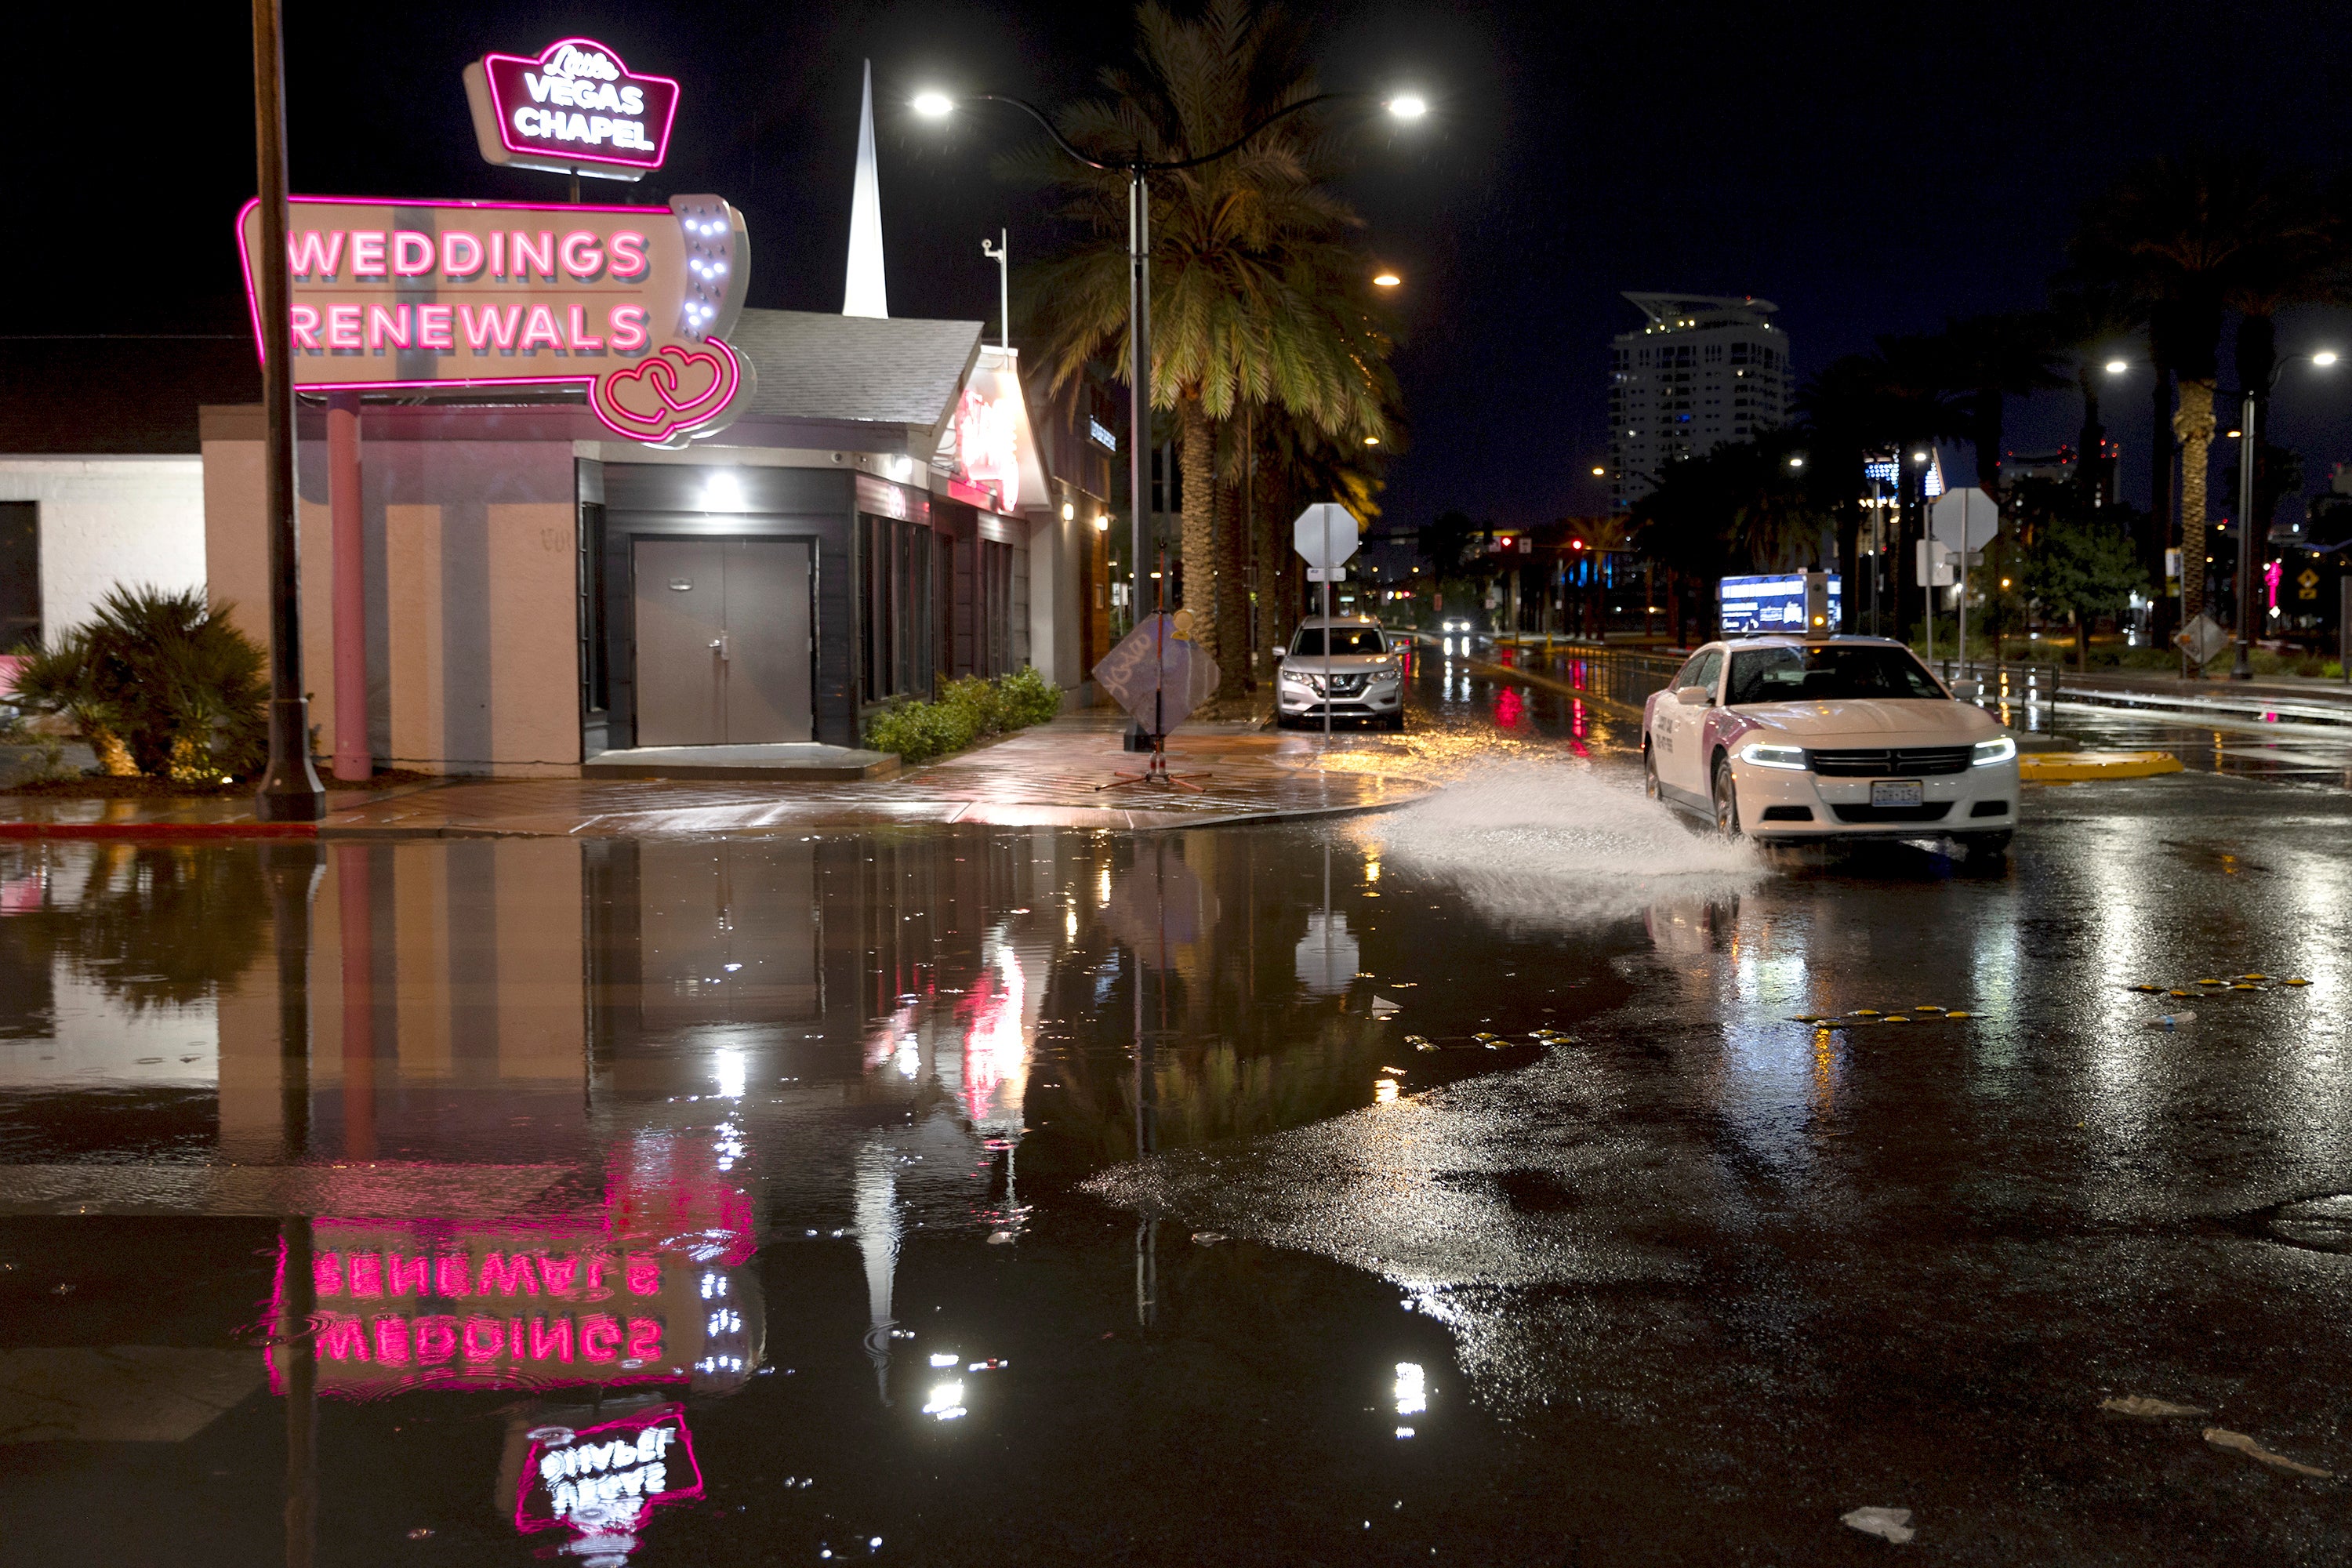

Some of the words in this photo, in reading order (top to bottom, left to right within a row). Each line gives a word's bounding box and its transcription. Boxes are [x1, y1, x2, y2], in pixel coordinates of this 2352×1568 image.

[524, 72, 644, 115] VEGAS
[514, 107, 655, 151] CHAPEL
[289, 230, 646, 277] WEDDINGS
[290, 303, 647, 350] RENEWALS
